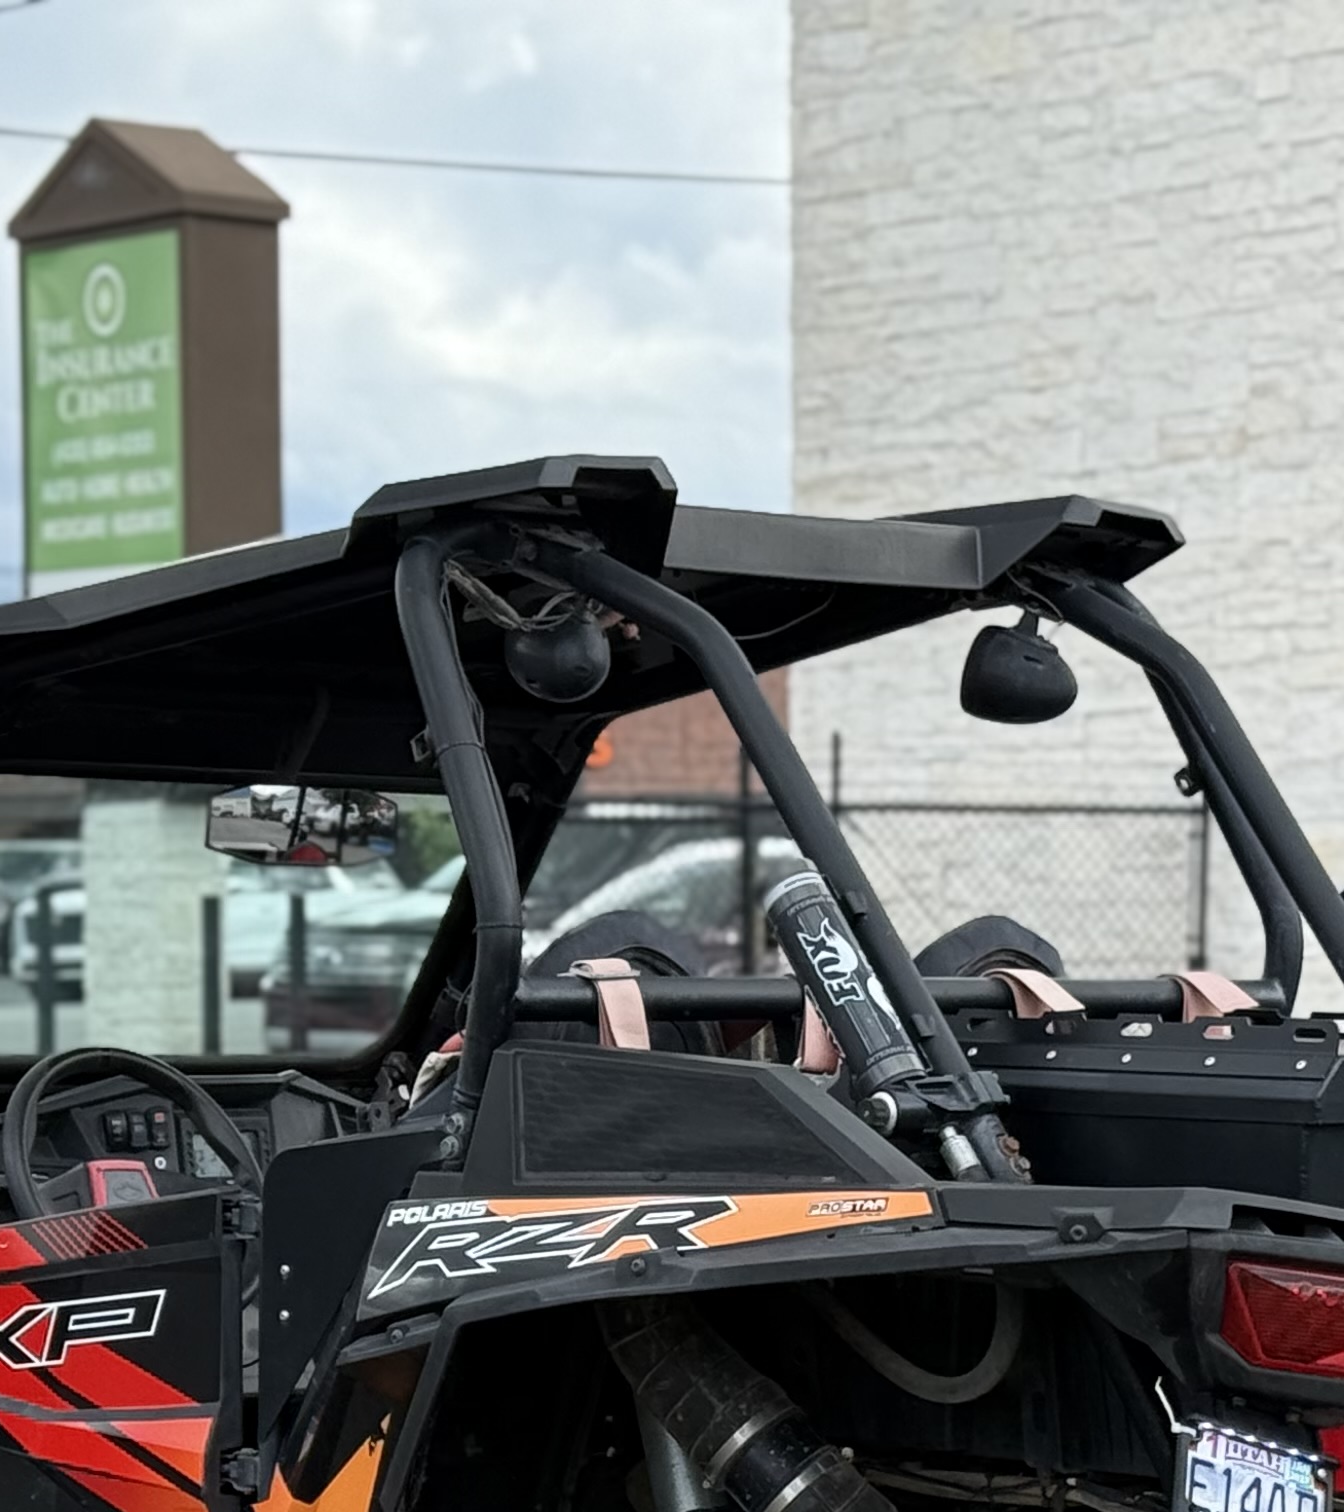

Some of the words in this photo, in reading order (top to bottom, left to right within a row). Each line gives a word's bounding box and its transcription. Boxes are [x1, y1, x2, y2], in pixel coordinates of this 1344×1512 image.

[35, 334, 175, 387] INSURANCE
[56, 377, 156, 423] CENTER
[796, 917, 865, 1006] FOX
[387, 1201, 488, 1227] POLARIS
[808, 1198, 889, 1216] PROSTAR
[366, 1195, 739, 1300] RZR
[1227, 1440, 1282, 1470] UTAH
